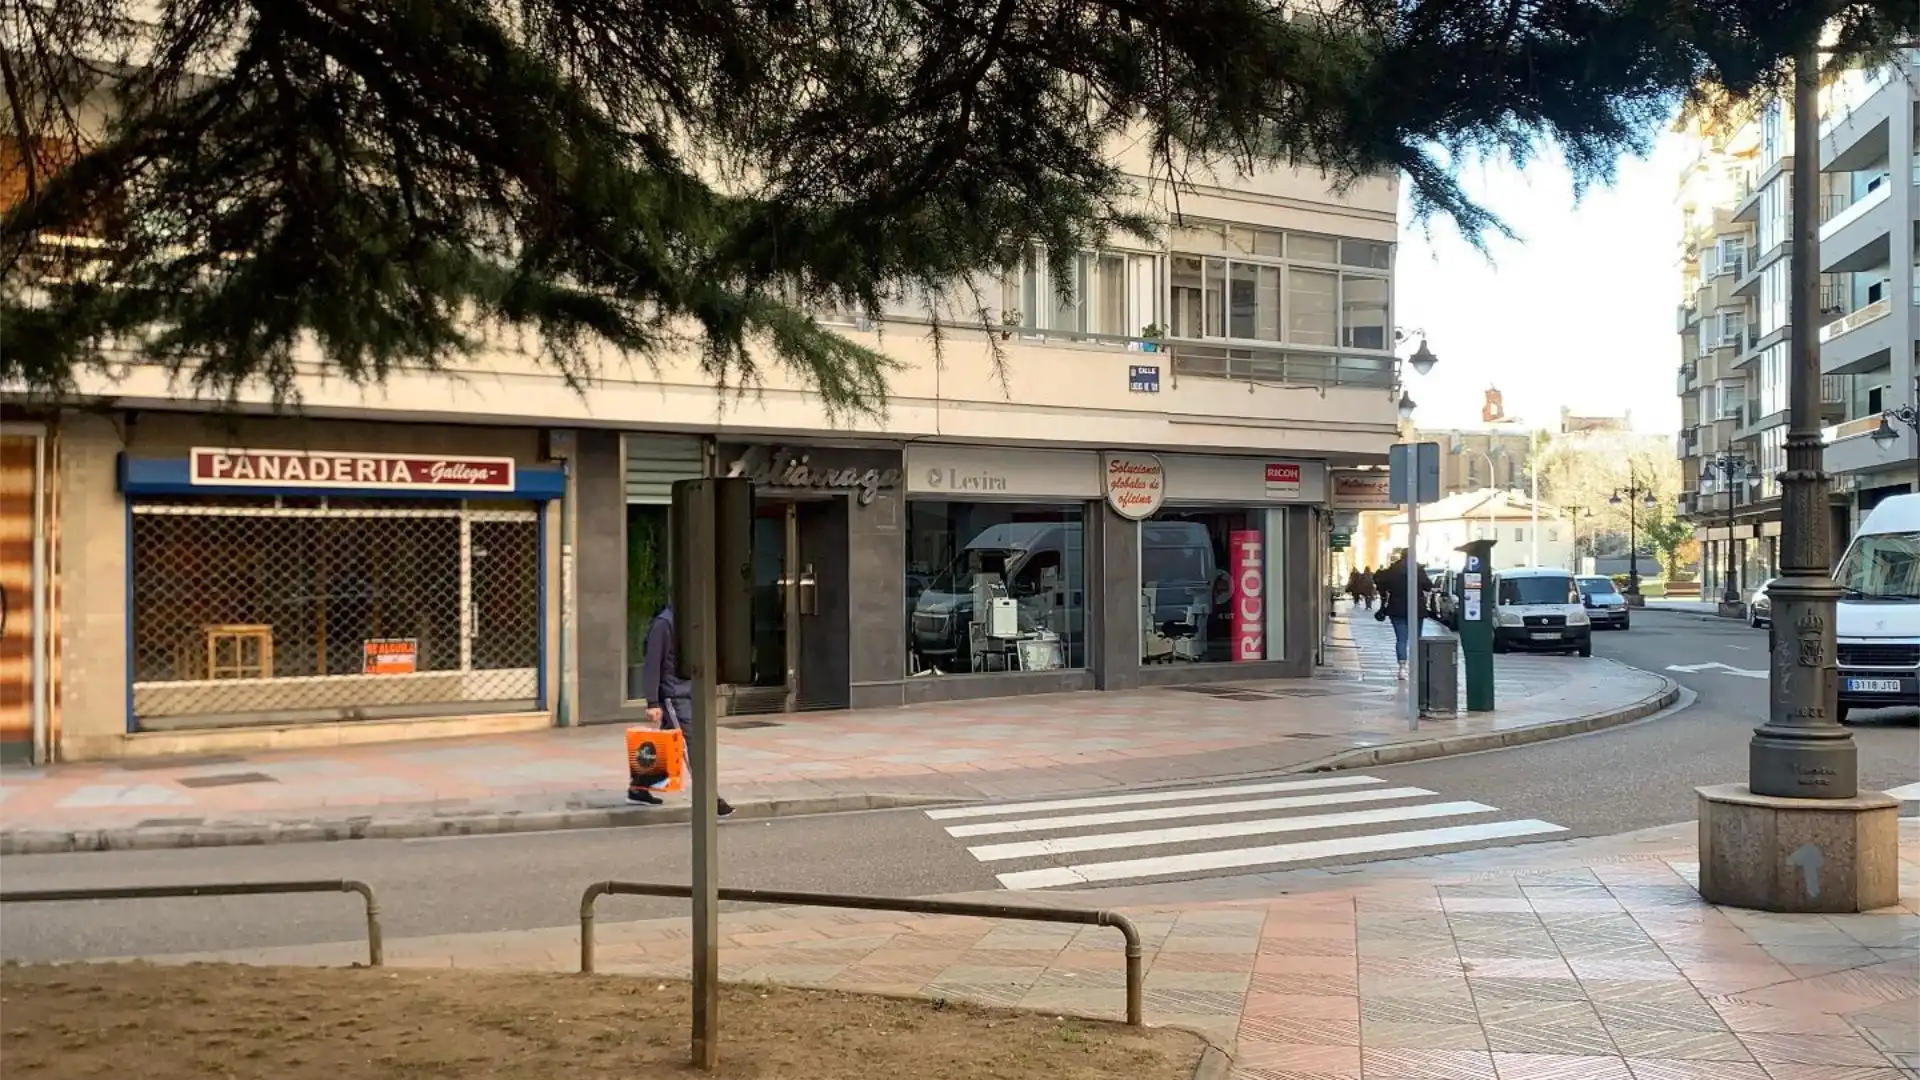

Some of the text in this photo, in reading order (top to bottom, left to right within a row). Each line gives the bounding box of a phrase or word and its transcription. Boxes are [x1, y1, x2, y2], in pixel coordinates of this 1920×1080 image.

[211, 453, 413, 483] PANADERIA
[1109, 459, 1160, 474] Soluciones
[1267, 468, 1298, 479] RICOH
[949, 468, 1007, 491] Levira
[1110, 476, 1160, 492] globales de
[1118, 492, 1152, 508] oficina
[1468, 555, 1480, 571] P
[1241, 542, 1262, 660] RICOH
[1854, 681, 1877, 690] 3118
